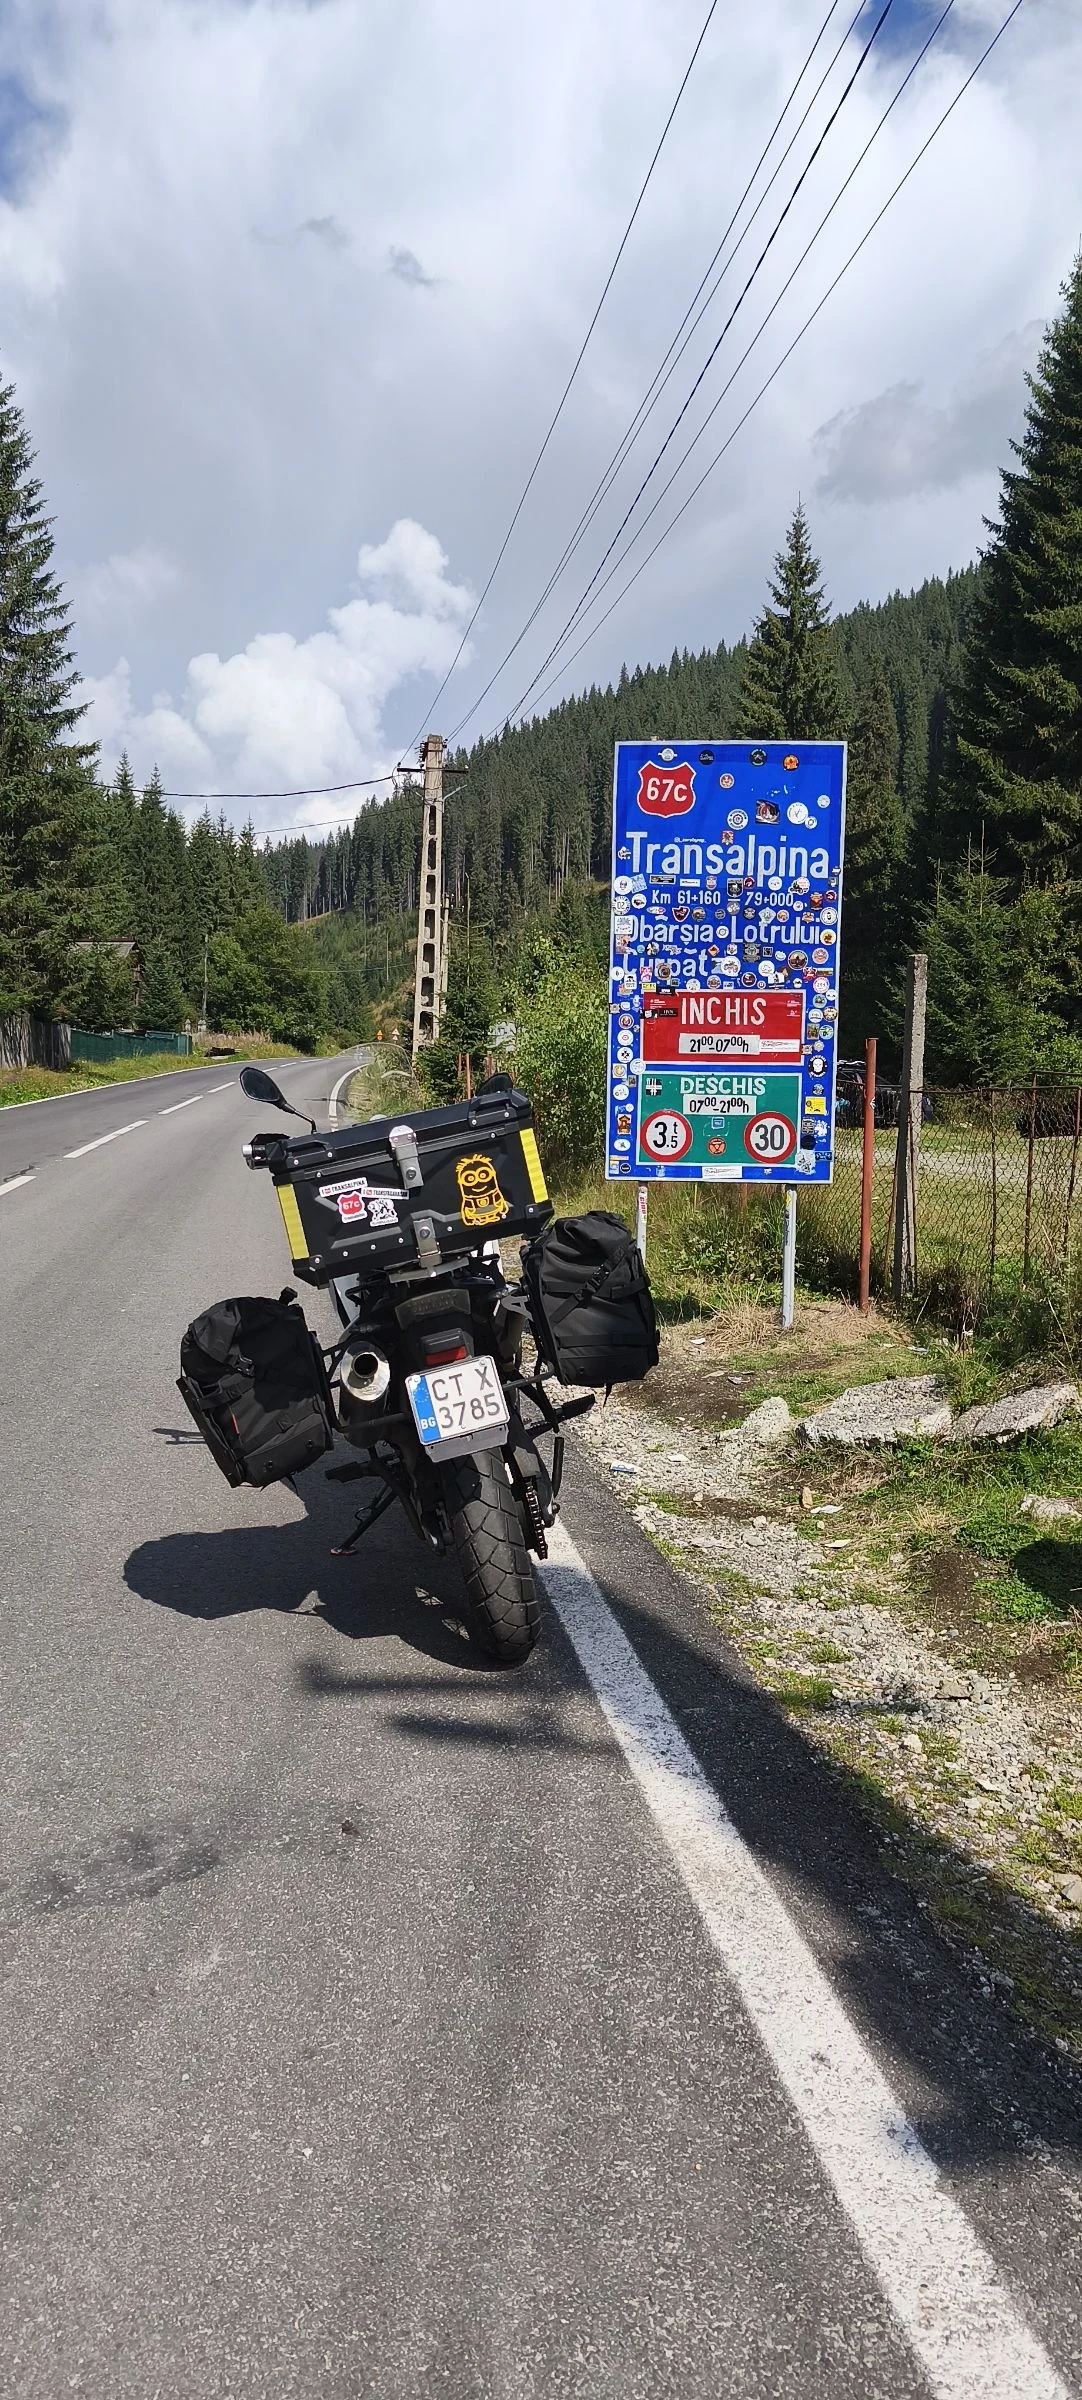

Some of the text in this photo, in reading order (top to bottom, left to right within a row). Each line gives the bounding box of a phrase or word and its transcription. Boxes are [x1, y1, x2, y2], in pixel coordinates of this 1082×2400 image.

[646, 777, 688, 802] 67c
[626, 831, 829, 888] Transalpina
[651, 889, 671, 904] Km
[677, 890, 721, 906] 61+160
[744, 891, 794, 907] 79+000
[730, 915, 820, 945] Lotrului
[681, 997, 767, 1026] INCHIS
[679, 1076, 767, 1096] DESCHIS
[754, 1124, 785, 1151] 30
[331, 1179, 366, 1193] TRANSALPINA
[431, 1366, 494, 1402] CT X
[420, 1416, 436, 1430] BG
[438, 1393, 500, 1429] 3785
